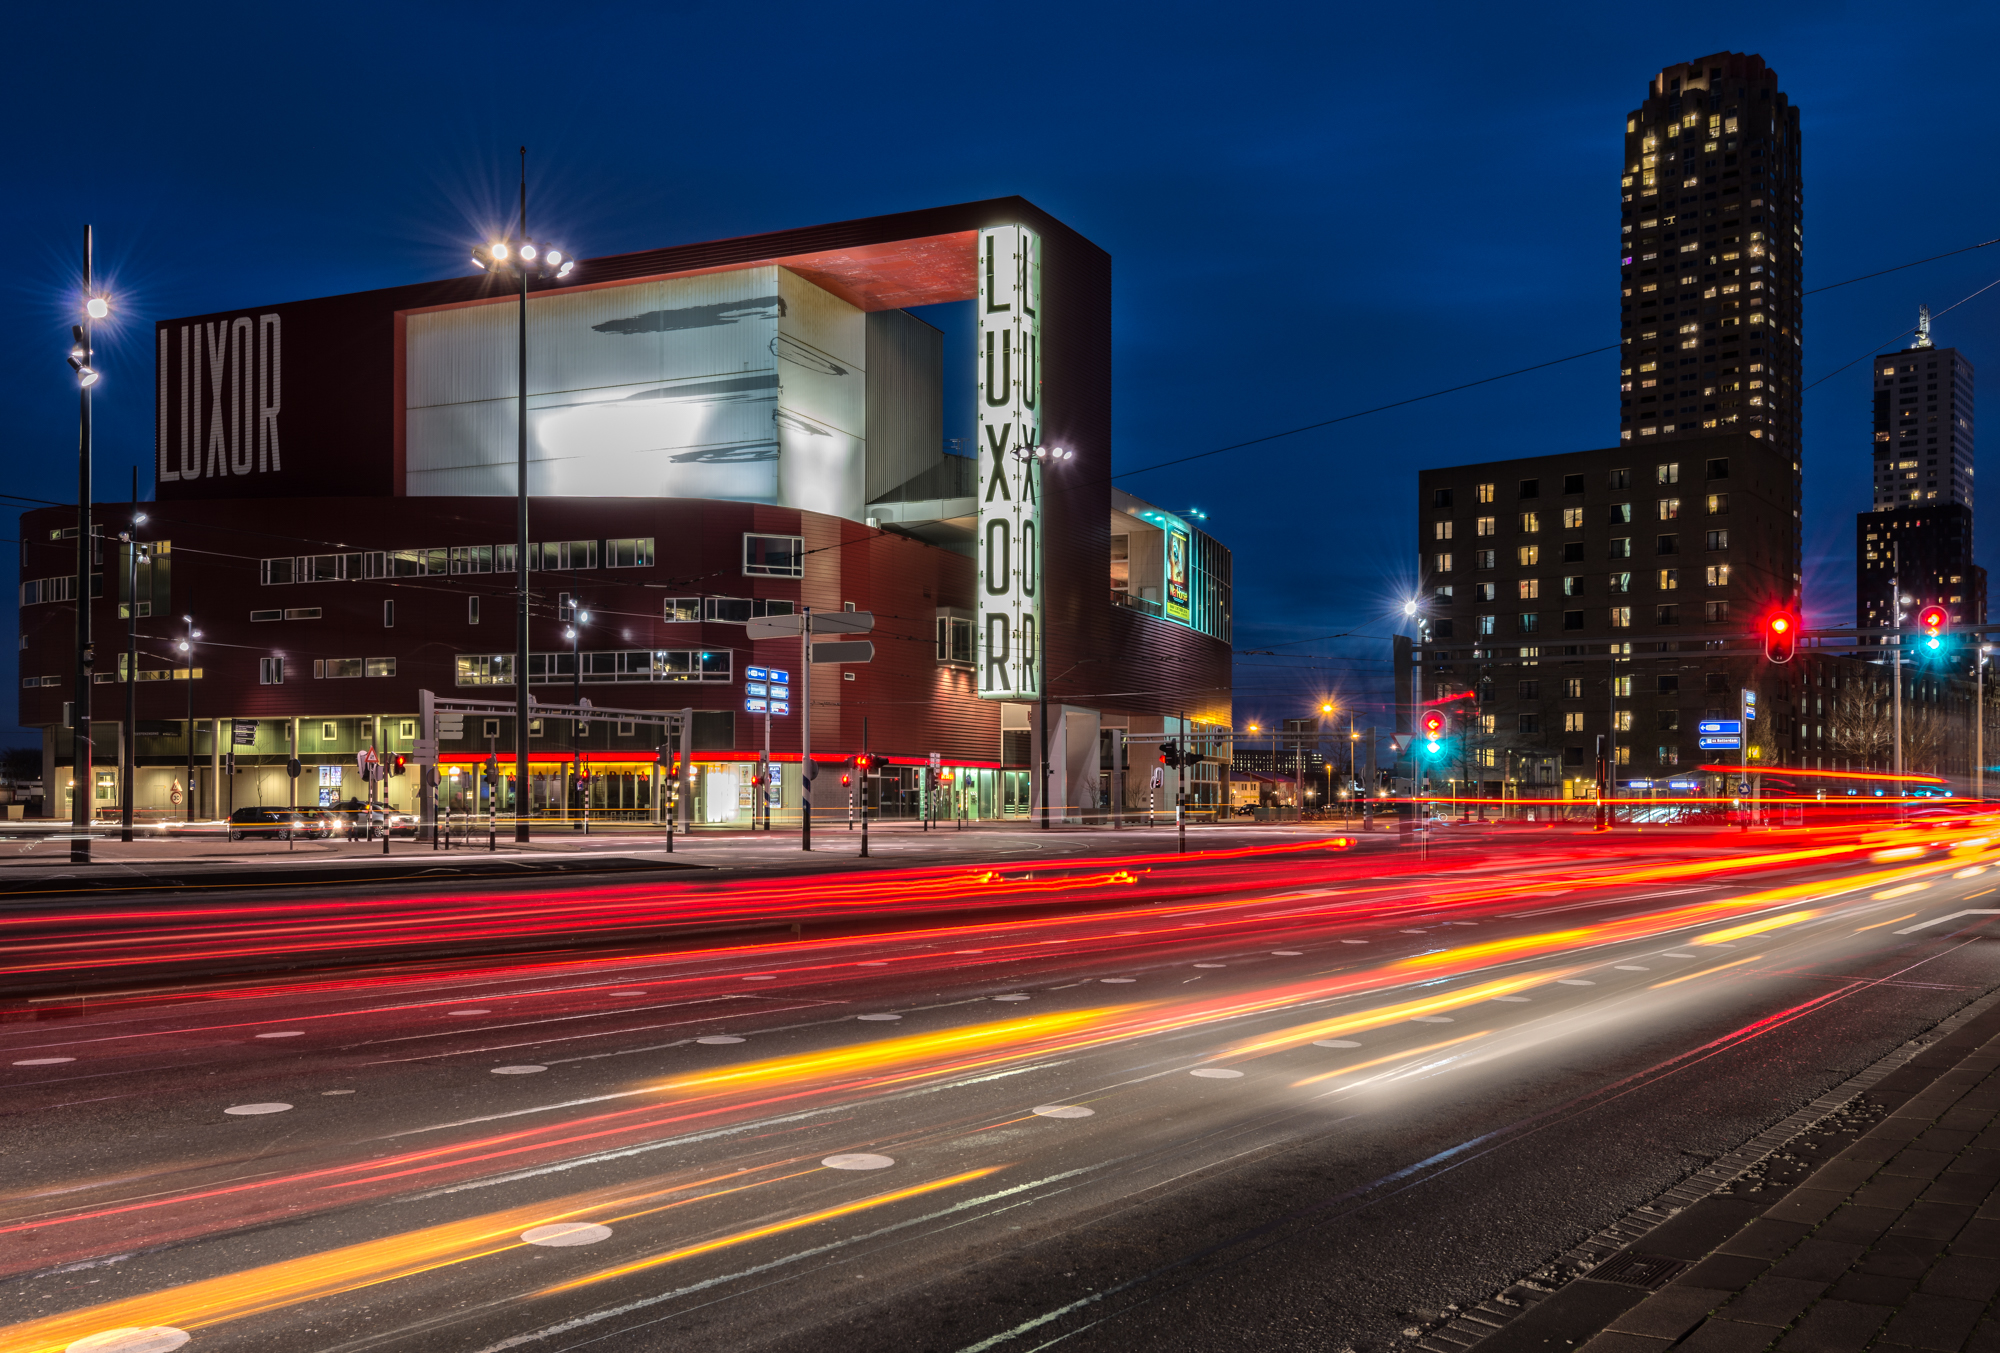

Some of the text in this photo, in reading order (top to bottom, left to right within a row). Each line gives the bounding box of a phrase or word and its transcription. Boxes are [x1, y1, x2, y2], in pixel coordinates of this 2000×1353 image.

[160, 312, 282, 482] LUXOR
[986, 235, 1011, 691] LUXOR
[1022, 234, 1036, 692] LUXOR
